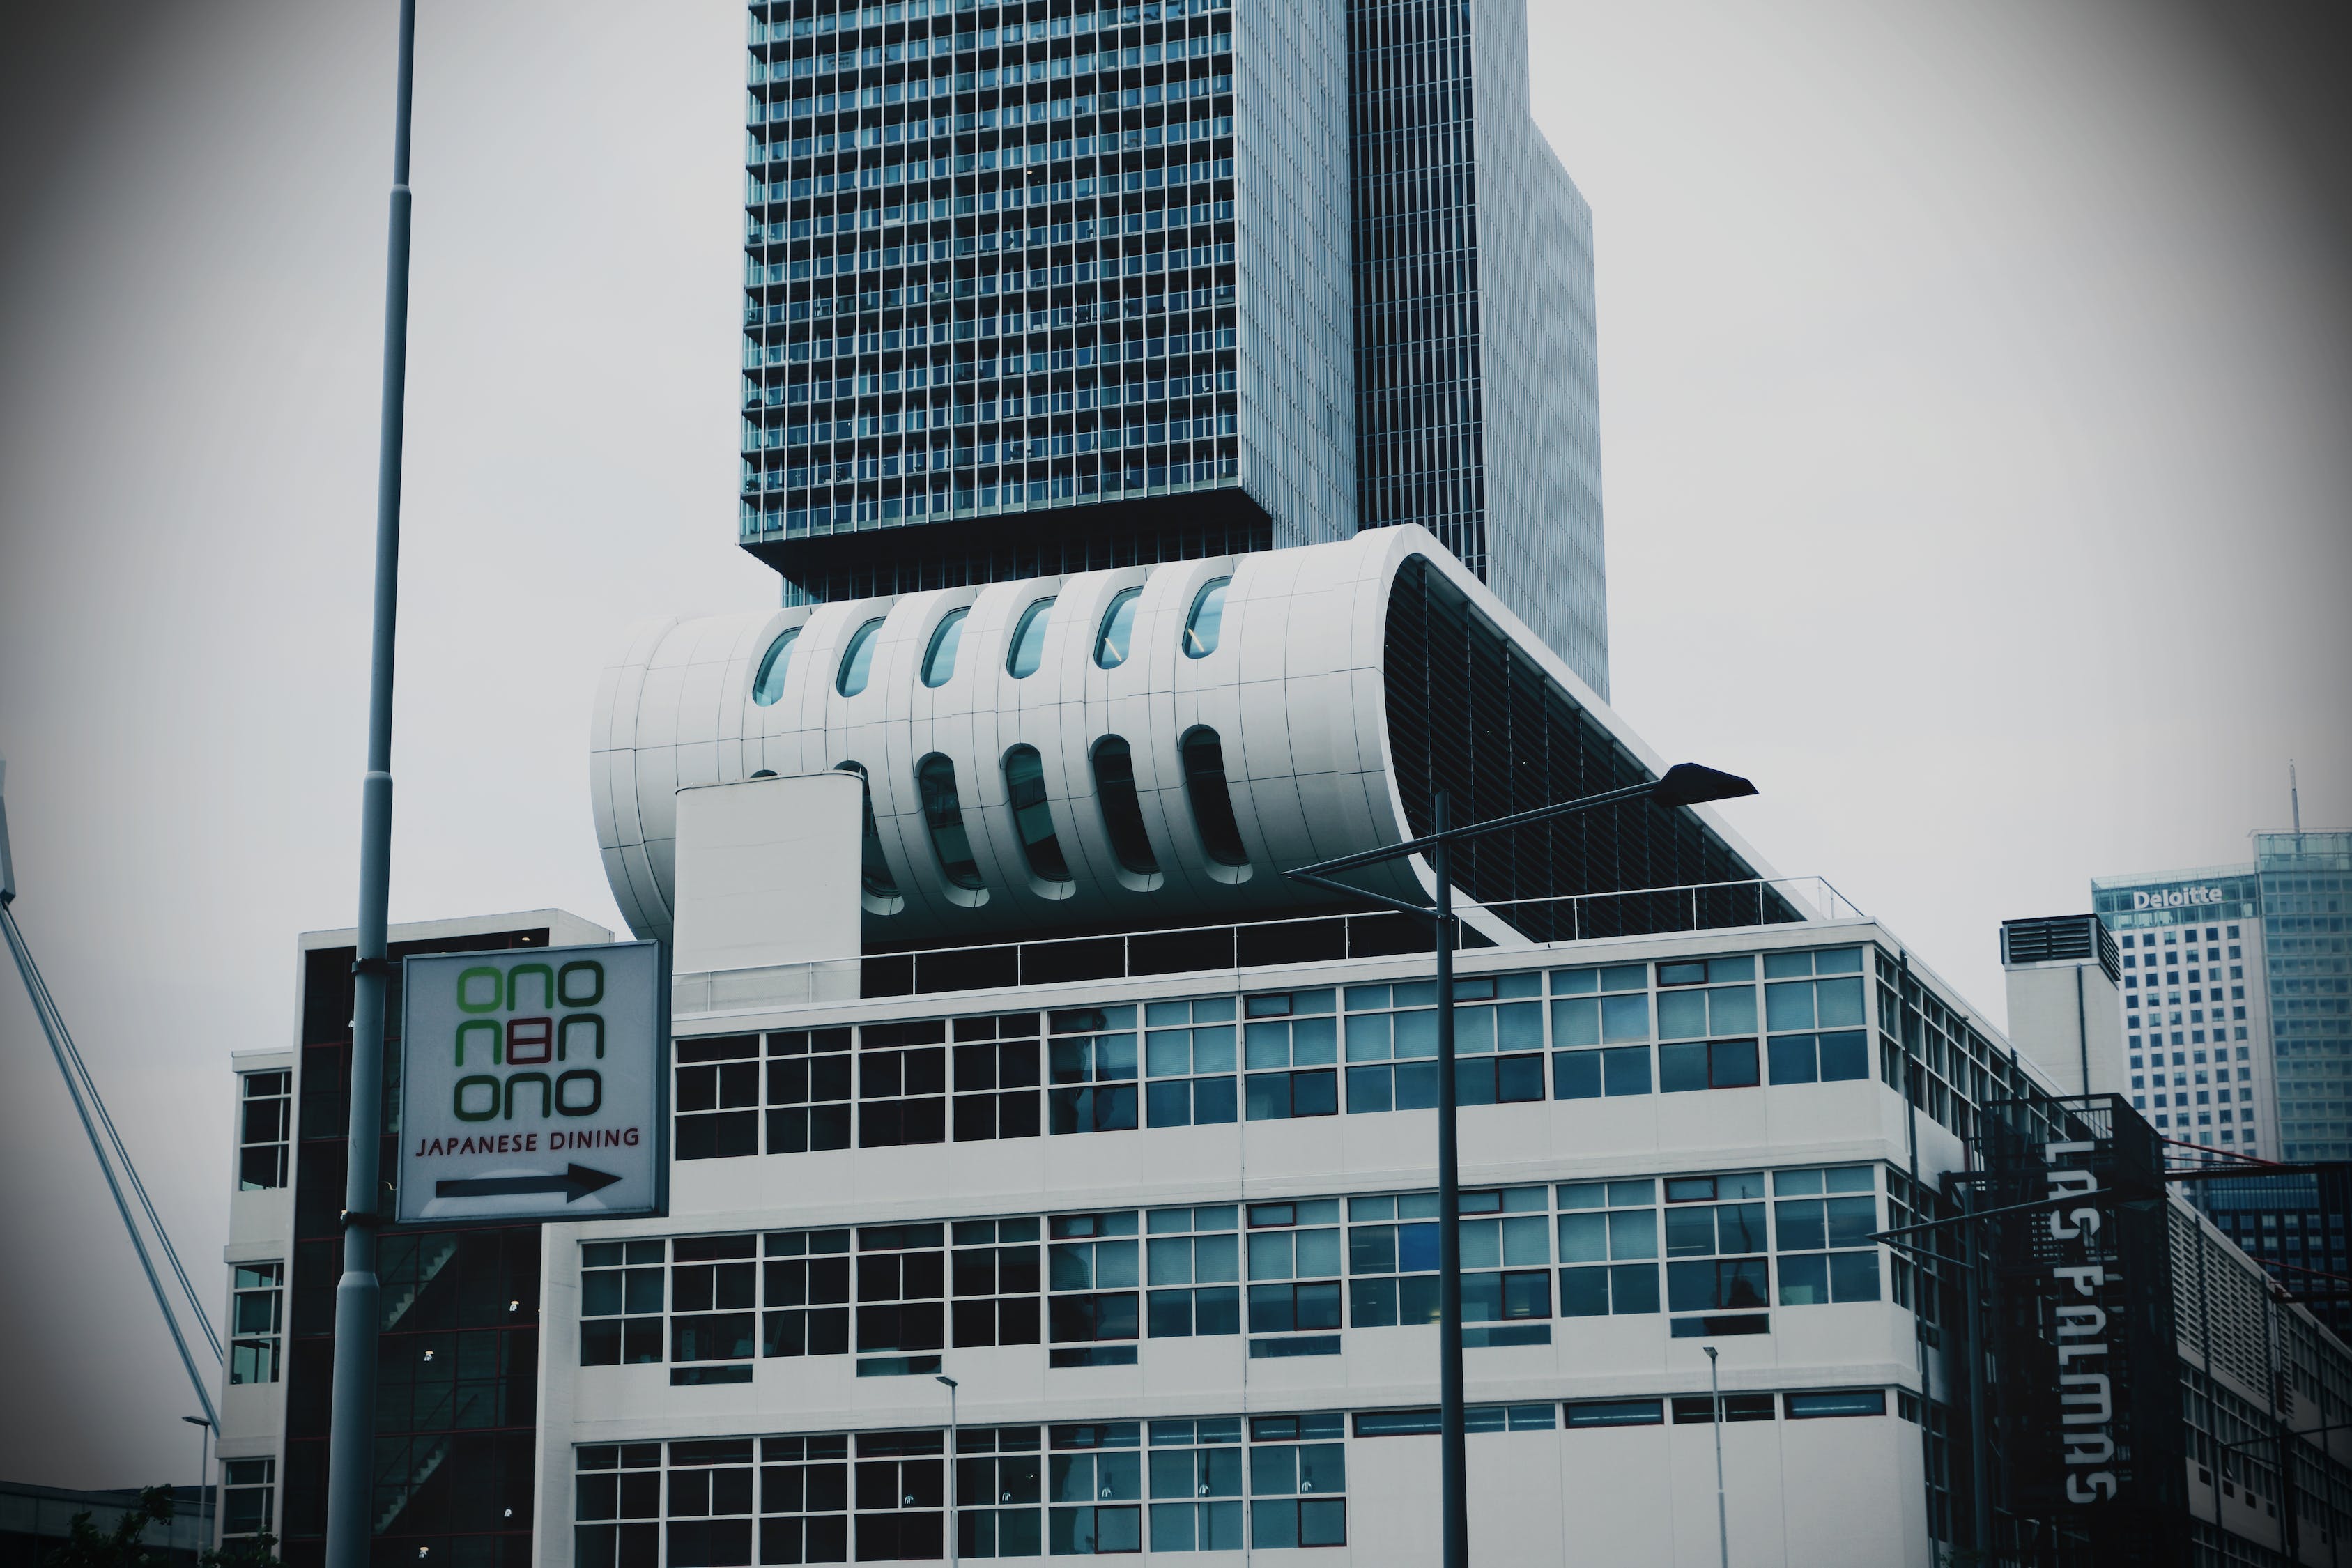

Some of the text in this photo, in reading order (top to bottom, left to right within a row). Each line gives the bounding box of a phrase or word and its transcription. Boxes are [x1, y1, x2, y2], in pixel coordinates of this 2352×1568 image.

[2133, 886, 2222, 909] Deloitte
[416, 1128, 639, 1157] JAPANESE DINING
[2053, 1265, 2118, 1504] PALMAS
